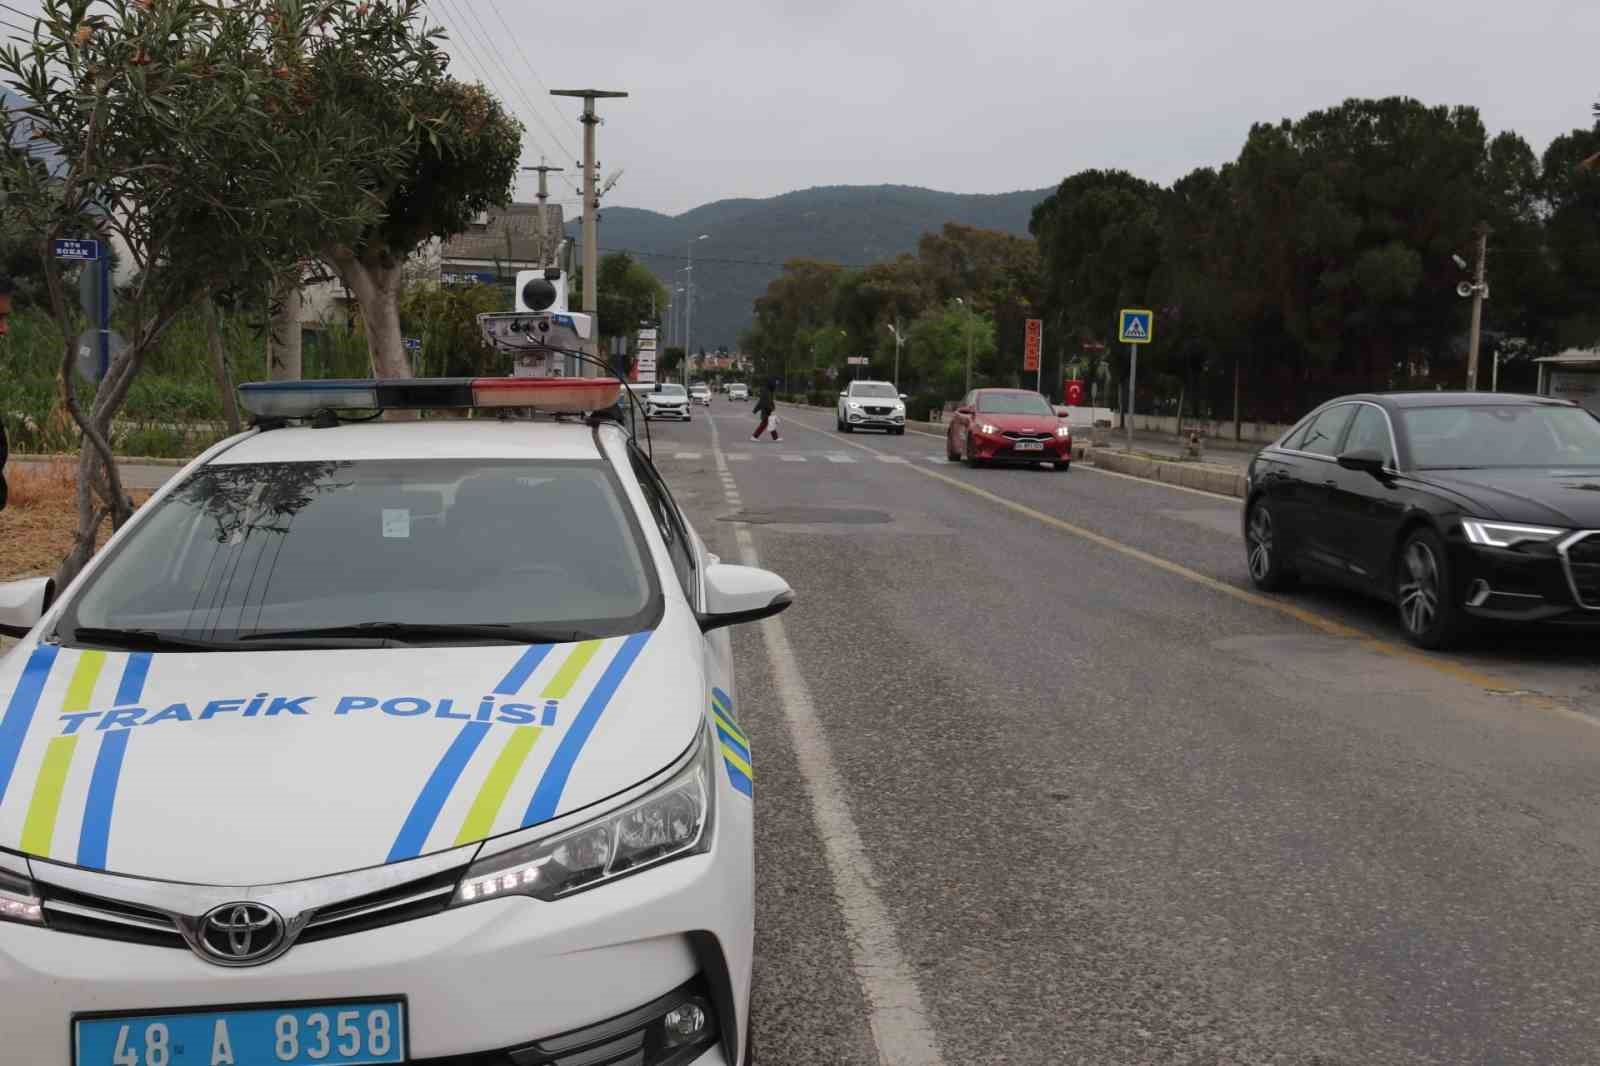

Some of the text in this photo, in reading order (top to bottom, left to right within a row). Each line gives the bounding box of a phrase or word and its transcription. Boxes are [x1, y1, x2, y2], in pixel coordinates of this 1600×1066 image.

[56, 248, 89, 256] SOKAK
[59, 692, 559, 735] TRAFİK POLİSİ
[112, 1008, 391, 1066] 48 A 8358
